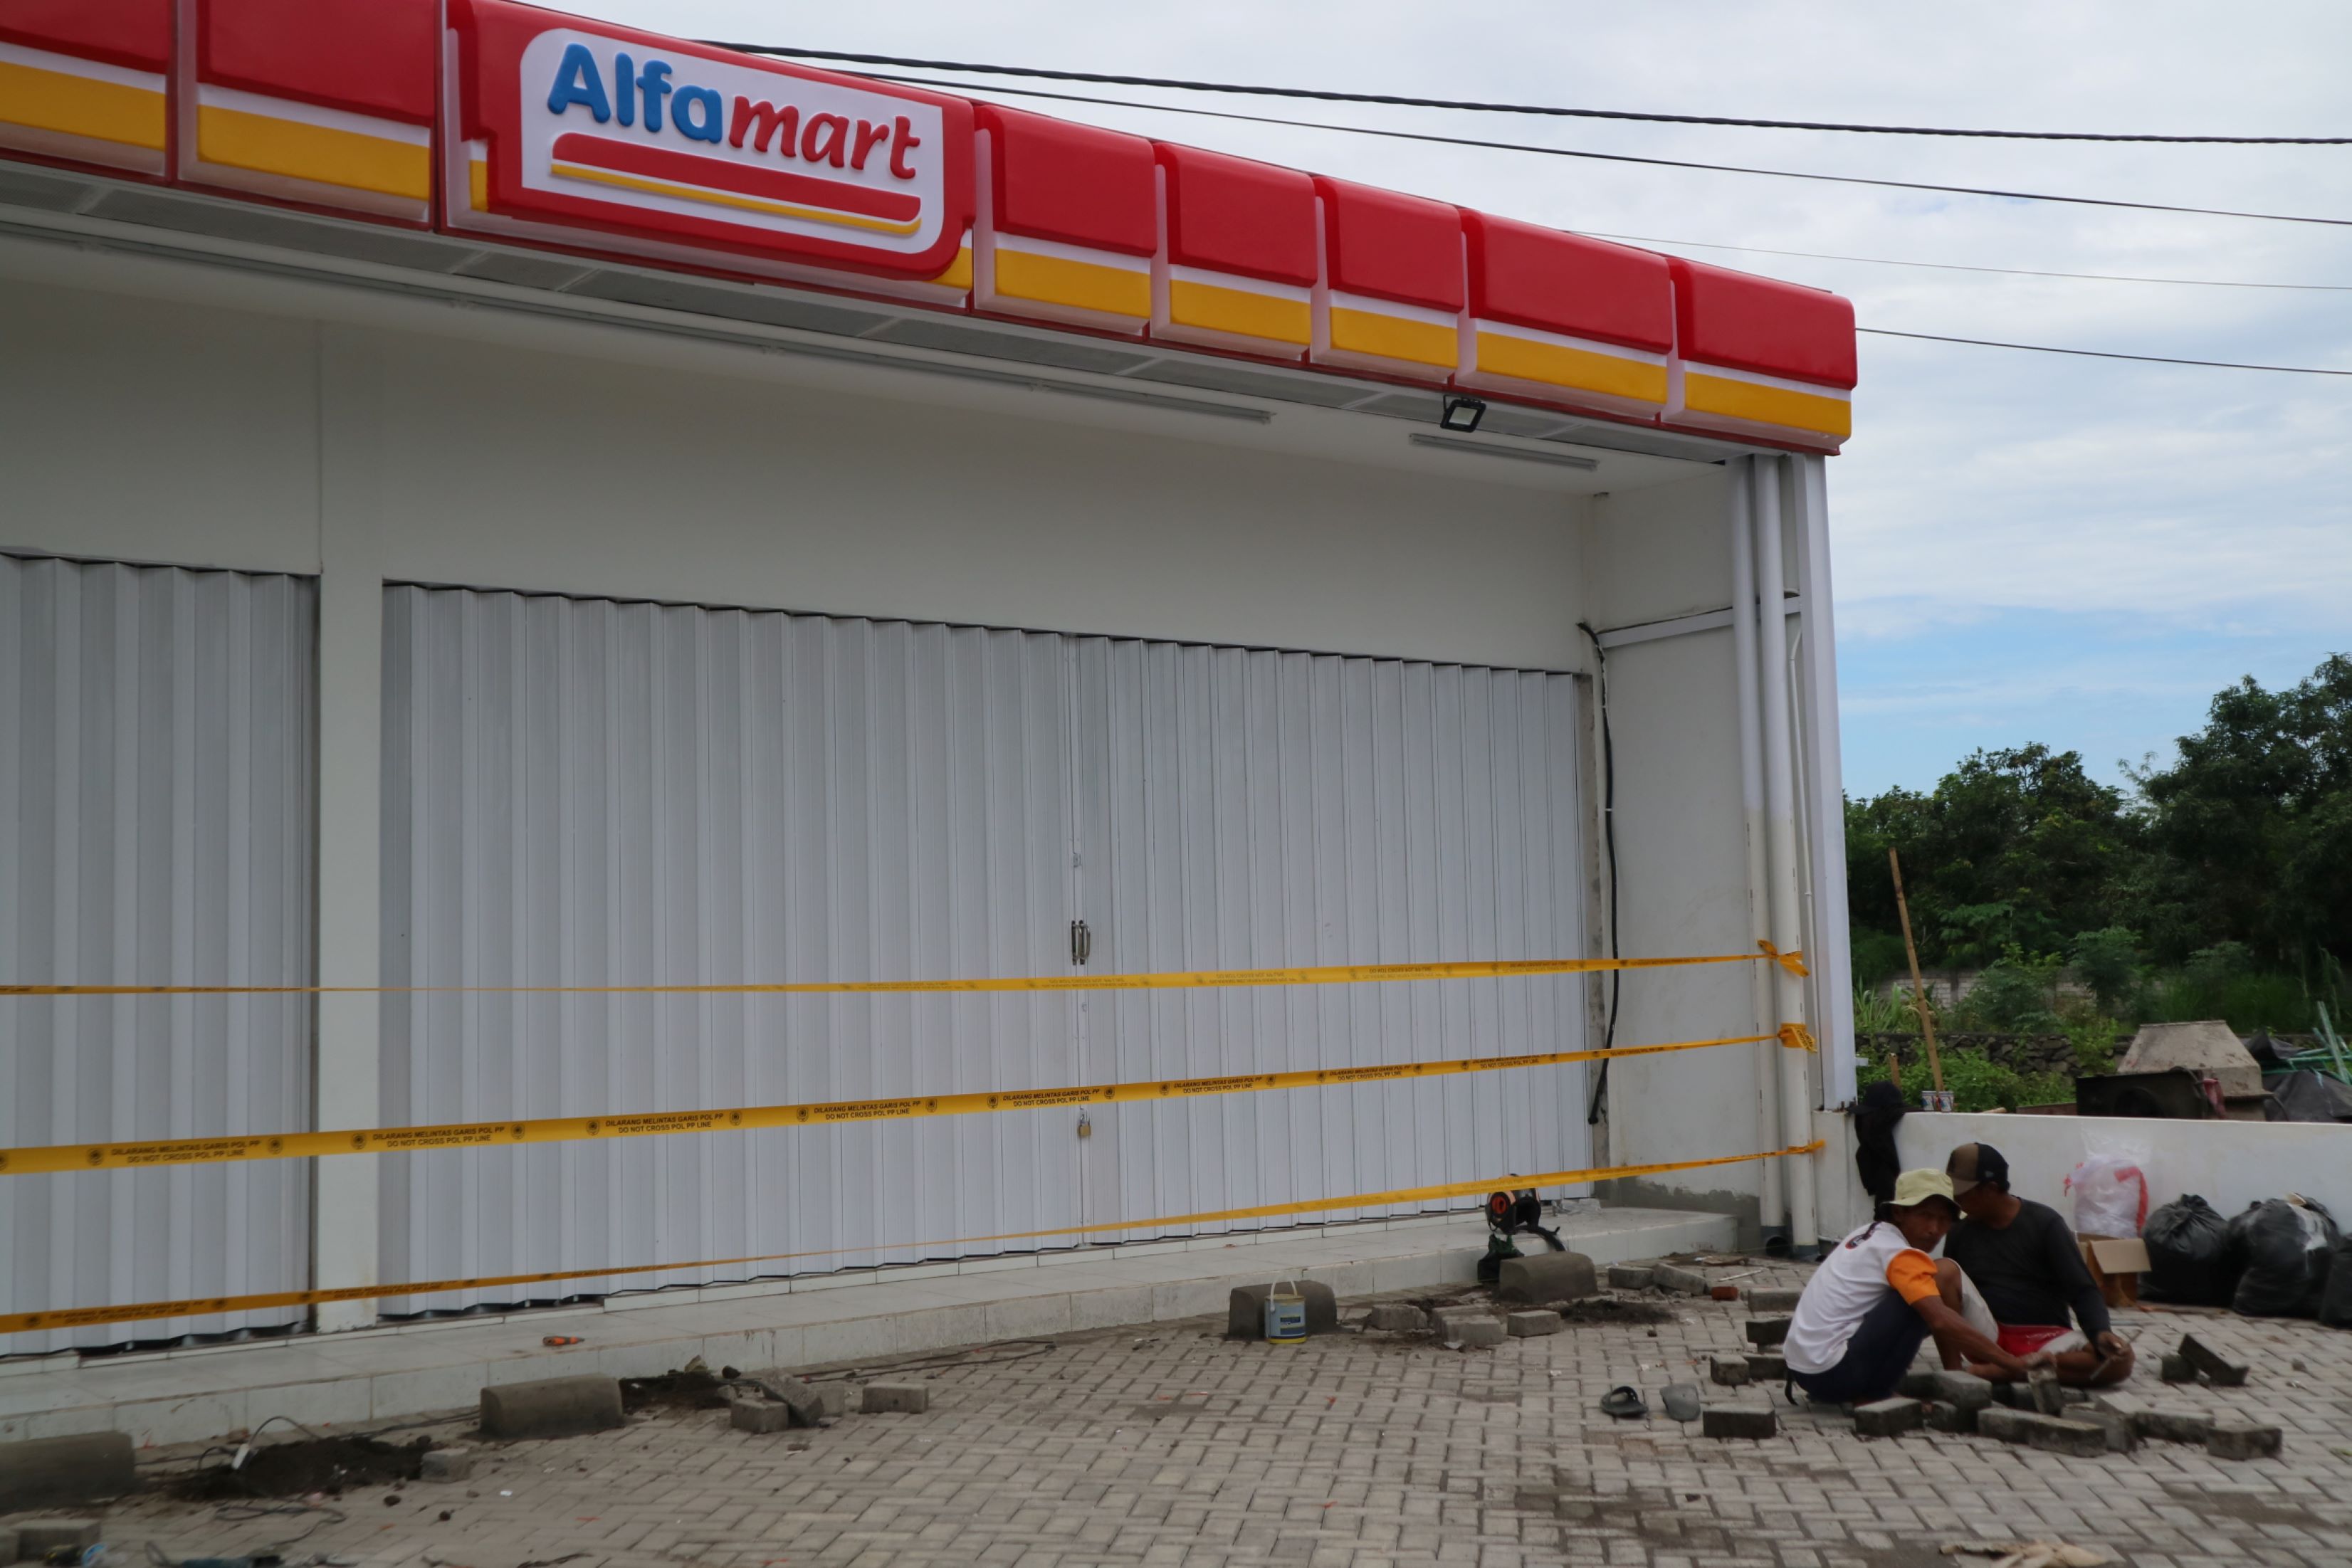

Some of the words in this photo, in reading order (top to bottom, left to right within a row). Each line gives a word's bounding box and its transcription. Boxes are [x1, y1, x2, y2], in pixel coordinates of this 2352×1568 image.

[547, 43, 920, 179] Alfamart
[642, 1116, 676, 1125] MELINTAS
[646, 1123, 671, 1132] CROSS
[373, 1132, 413, 1140] DILARANG
[414, 1129, 451, 1137] MELINTAS
